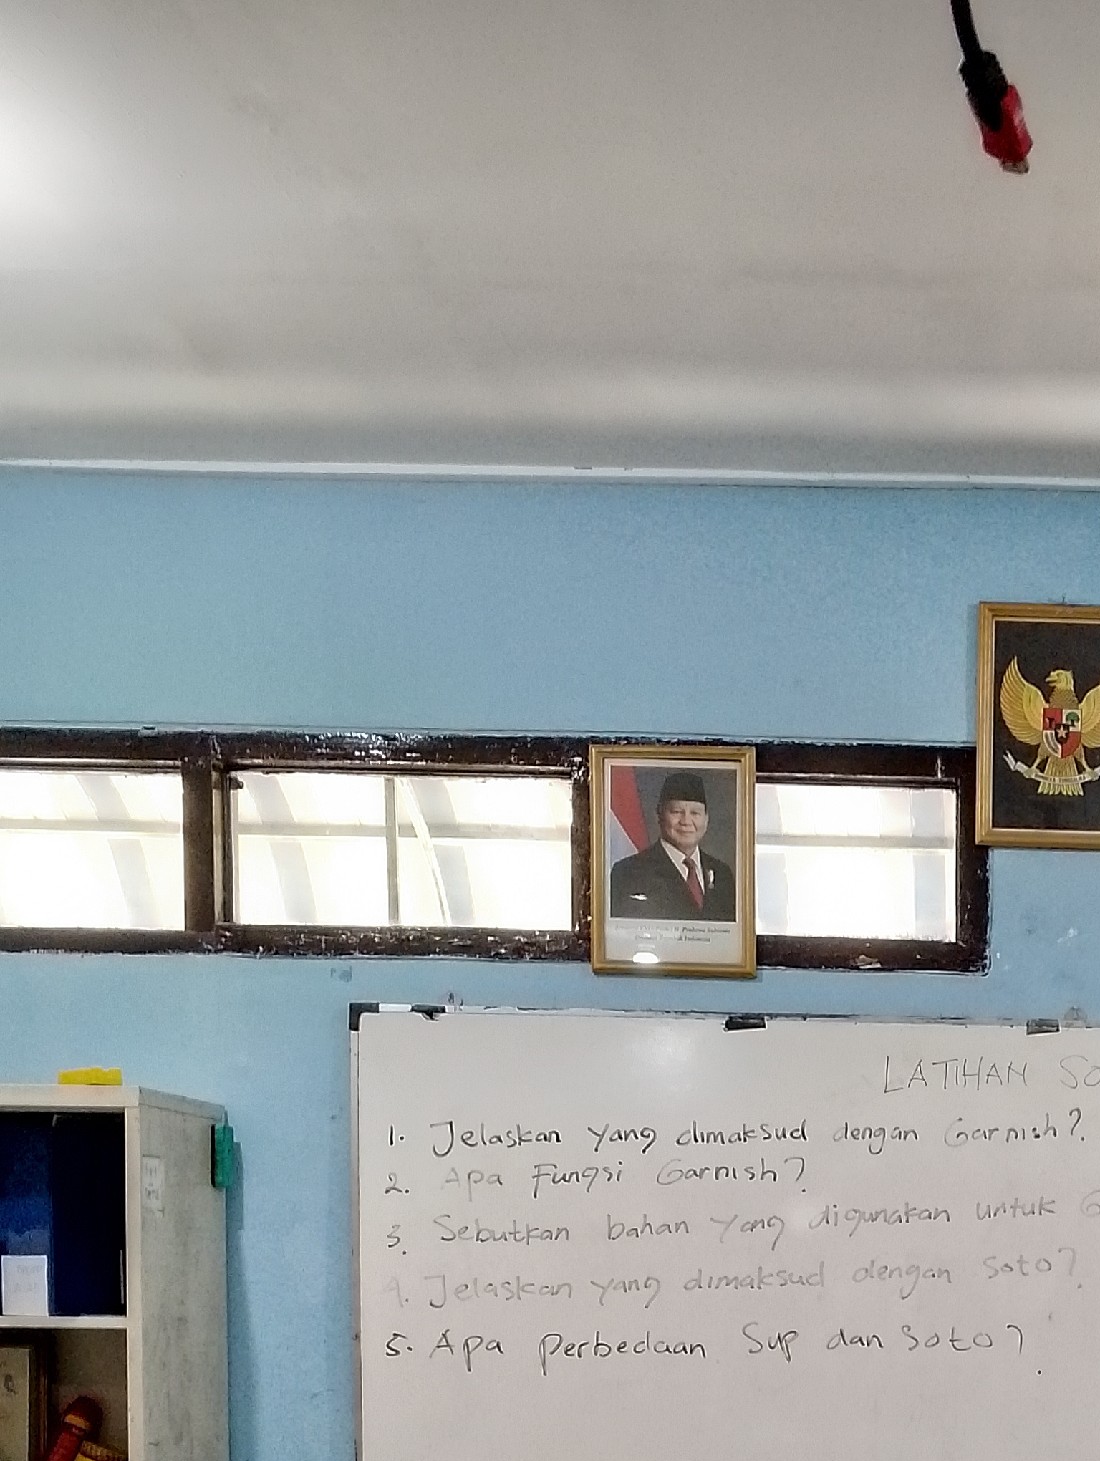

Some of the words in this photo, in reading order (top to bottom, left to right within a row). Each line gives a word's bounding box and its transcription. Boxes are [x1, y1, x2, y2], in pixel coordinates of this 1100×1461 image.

[883, 1055, 1029, 1094] LATIHAN
[387, 1123, 405, 1147] 1.
[430, 1120, 563, 1158] Jelaskan
[675, 1120, 809, 1147] dimaksud
[833, 1120, 919, 1155] dengan
[384, 1175, 411, 1195] 2.
[440, 1165, 504, 1203] Apa
[531, 1160, 625, 1200] Fungsi
[386, 1223, 408, 1257] 3.
[432, 1213, 571, 1247] Sebutkan
[606, 1213, 691, 1242] bahan
[808, 1203, 953, 1238] digunakan
[975, 1195, 1057, 1221] untuk
[423, 1273, 574, 1309] Jelaskan
[683, 1261, 825, 1293] dimaksud
[852, 1259, 952, 1301] dengan
[385, 1331, 414, 1357] 5.
[428, 1328, 505, 1374] Apa
[741, 1321, 801, 1365] Sup
[826, 1327, 885, 1351] dan
